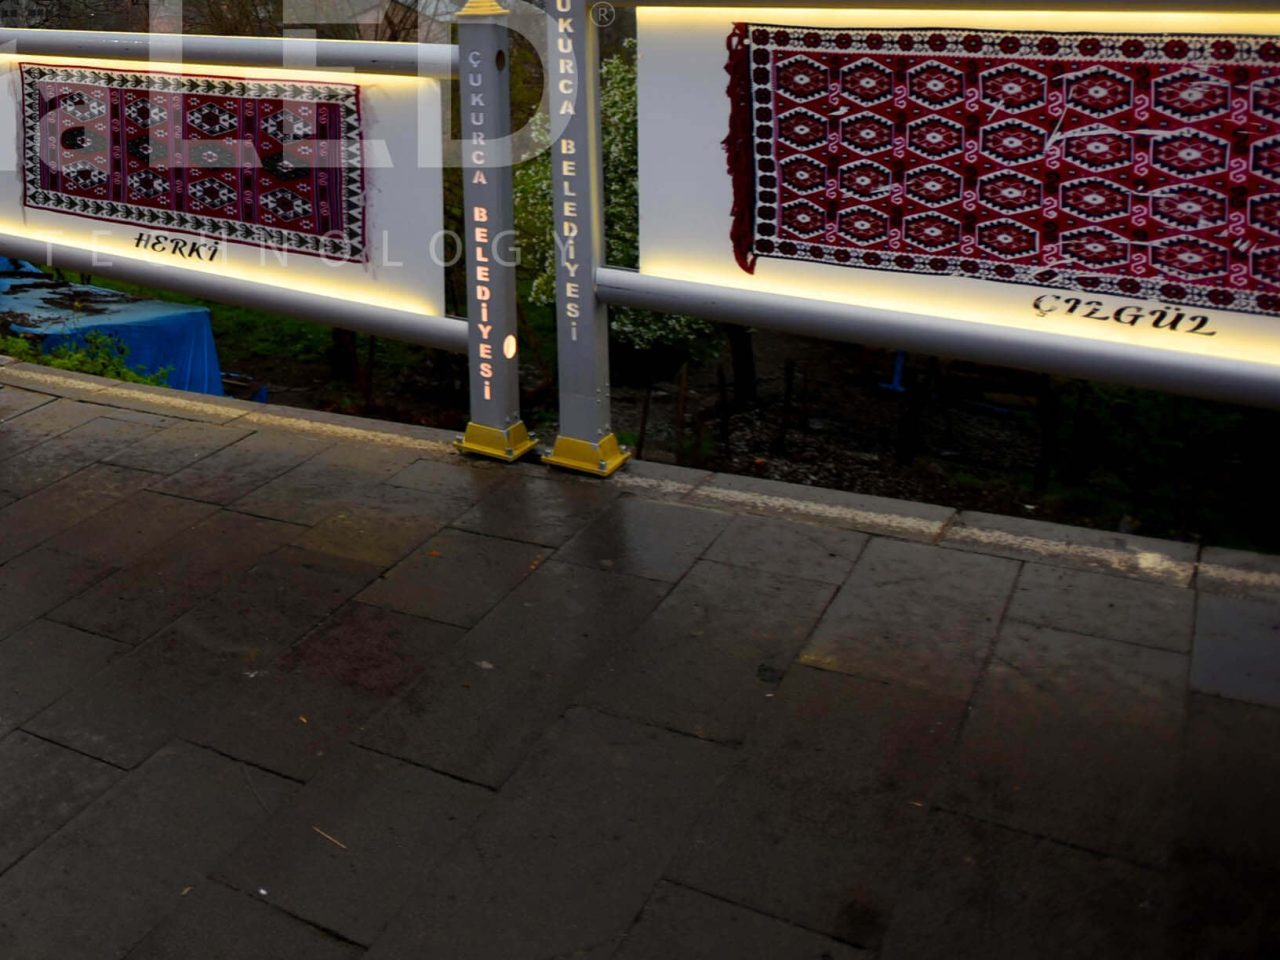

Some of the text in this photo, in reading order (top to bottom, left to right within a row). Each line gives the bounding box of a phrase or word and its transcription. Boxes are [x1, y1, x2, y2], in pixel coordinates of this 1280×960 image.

[468, 51, 493, 401] ÇUKURCA BELEDİYESİ
[561, 139, 581, 341] BELEDİYESİ
